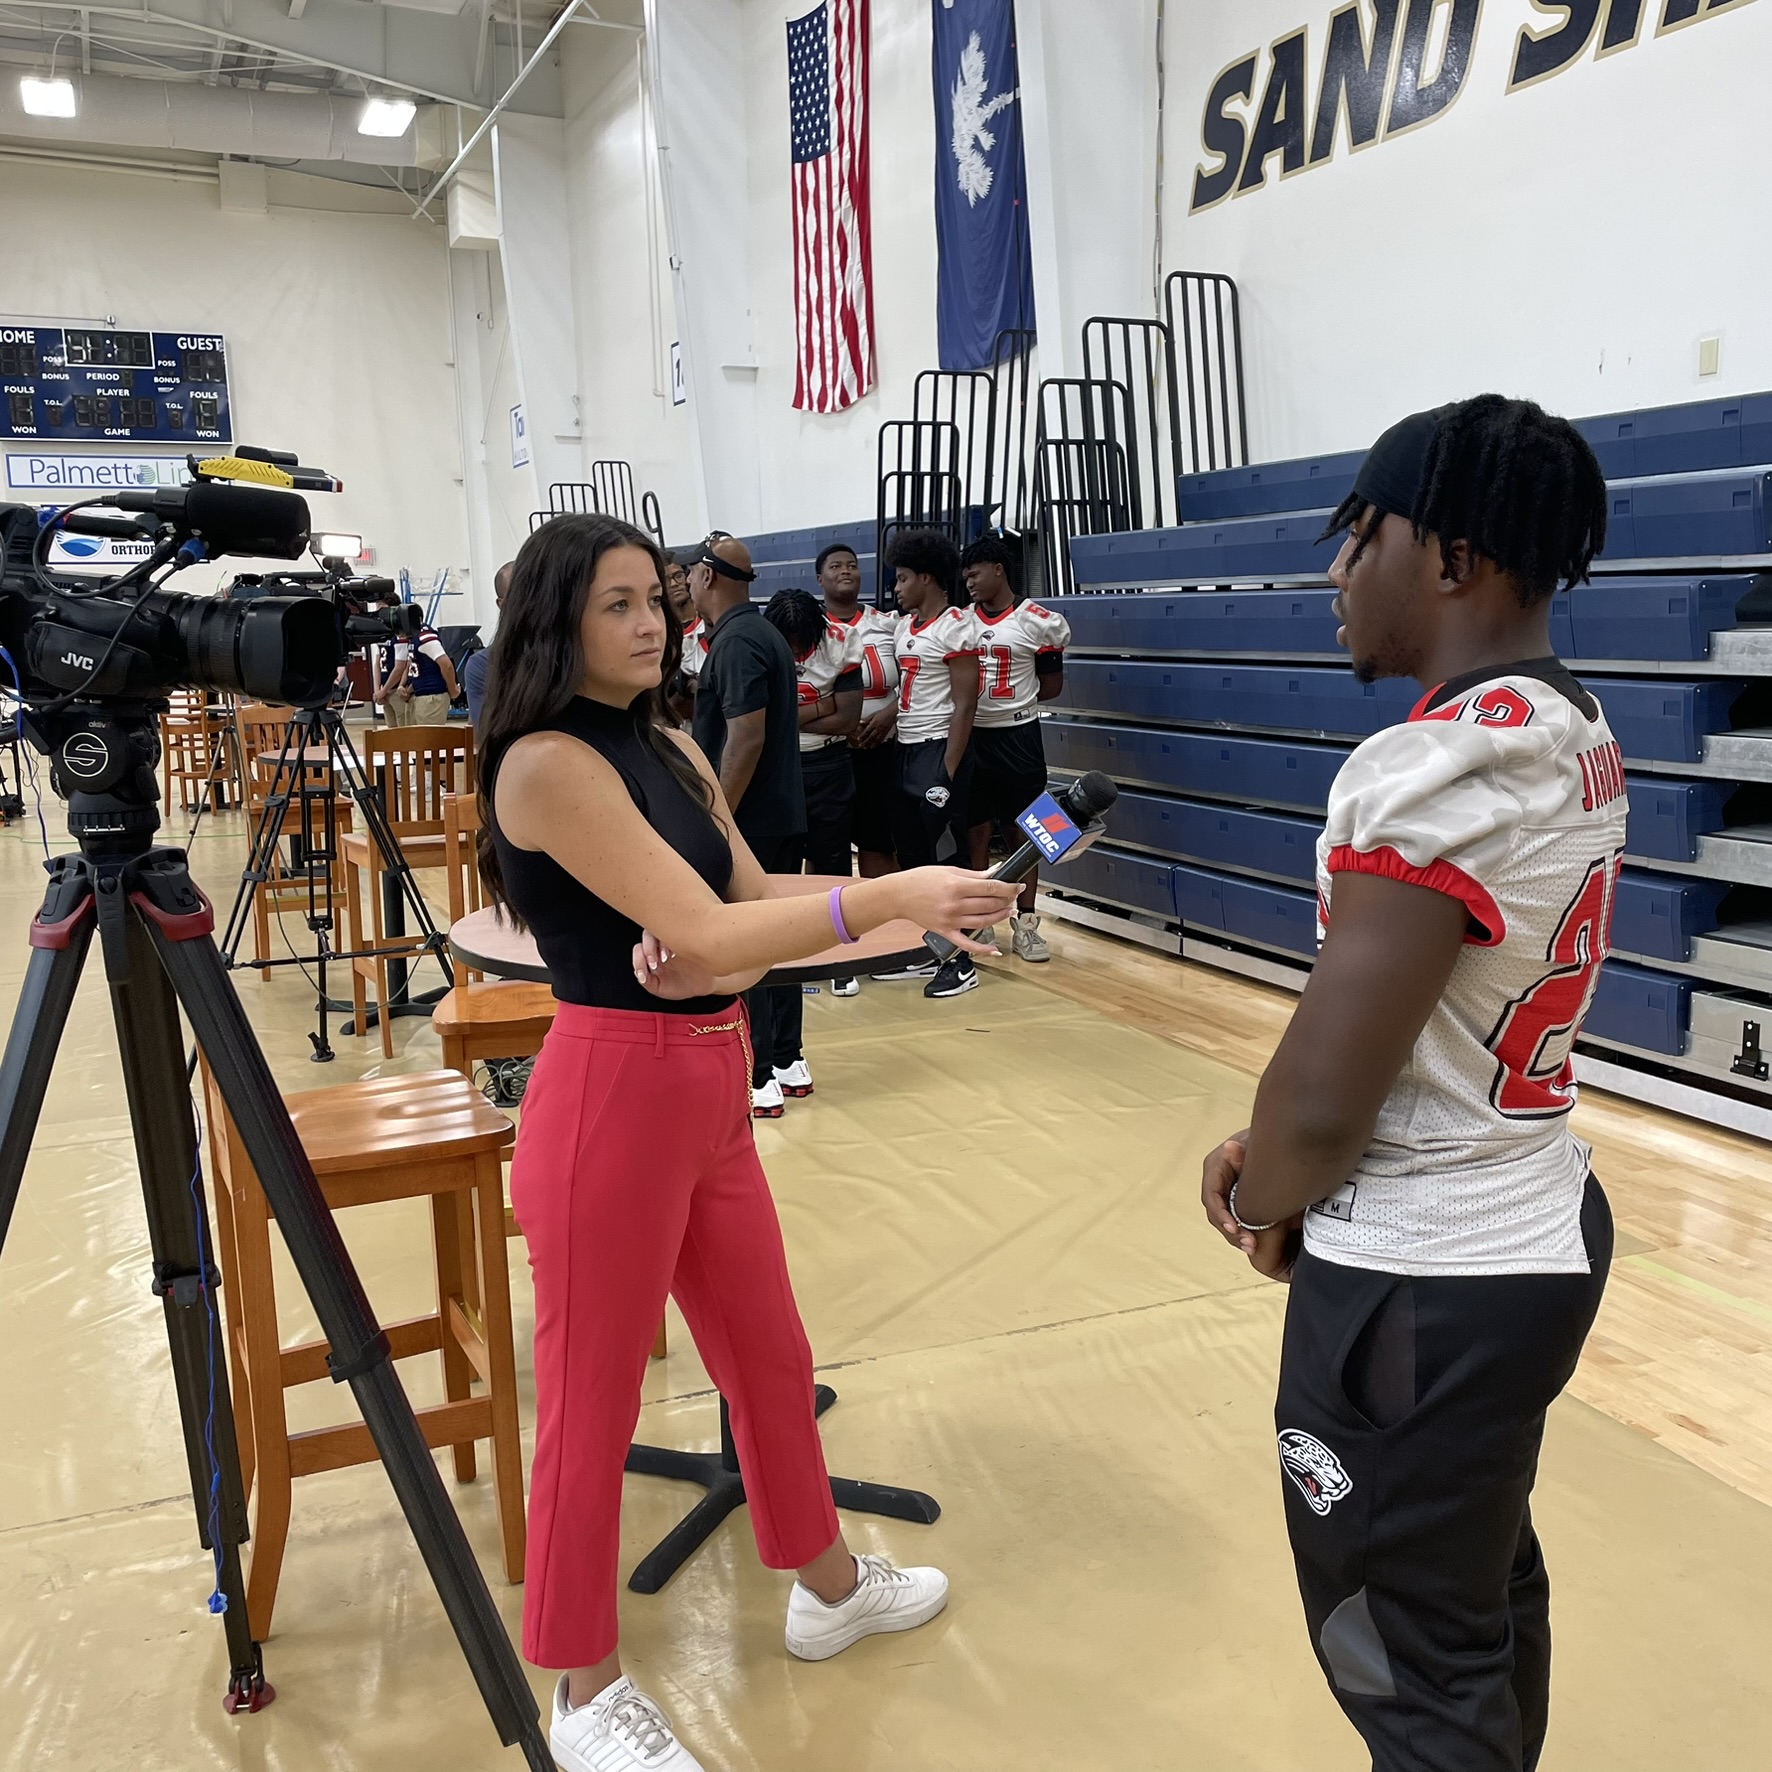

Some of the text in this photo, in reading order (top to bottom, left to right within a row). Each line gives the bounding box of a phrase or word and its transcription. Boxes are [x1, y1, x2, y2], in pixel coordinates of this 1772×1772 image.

[1188, 0, 1485, 216] SAND
[177, 337, 223, 351] GUEST
[86, 372, 120, 381] PERIOD
[154, 376, 180, 384] BONUS
[4, 385, 35, 394] FOULS
[96, 388, 130, 397] PLAYER
[189, 391, 219, 400] FOULS
[11, 425, 37, 434] WON
[104, 427, 131, 436] GAME
[196, 430, 220, 438] WON
[61, 652, 94, 671] JVC
[899, 655, 921, 713] 7
[1024, 813, 1060, 853] WTOC
[1330, 1202, 1340, 1213] M
